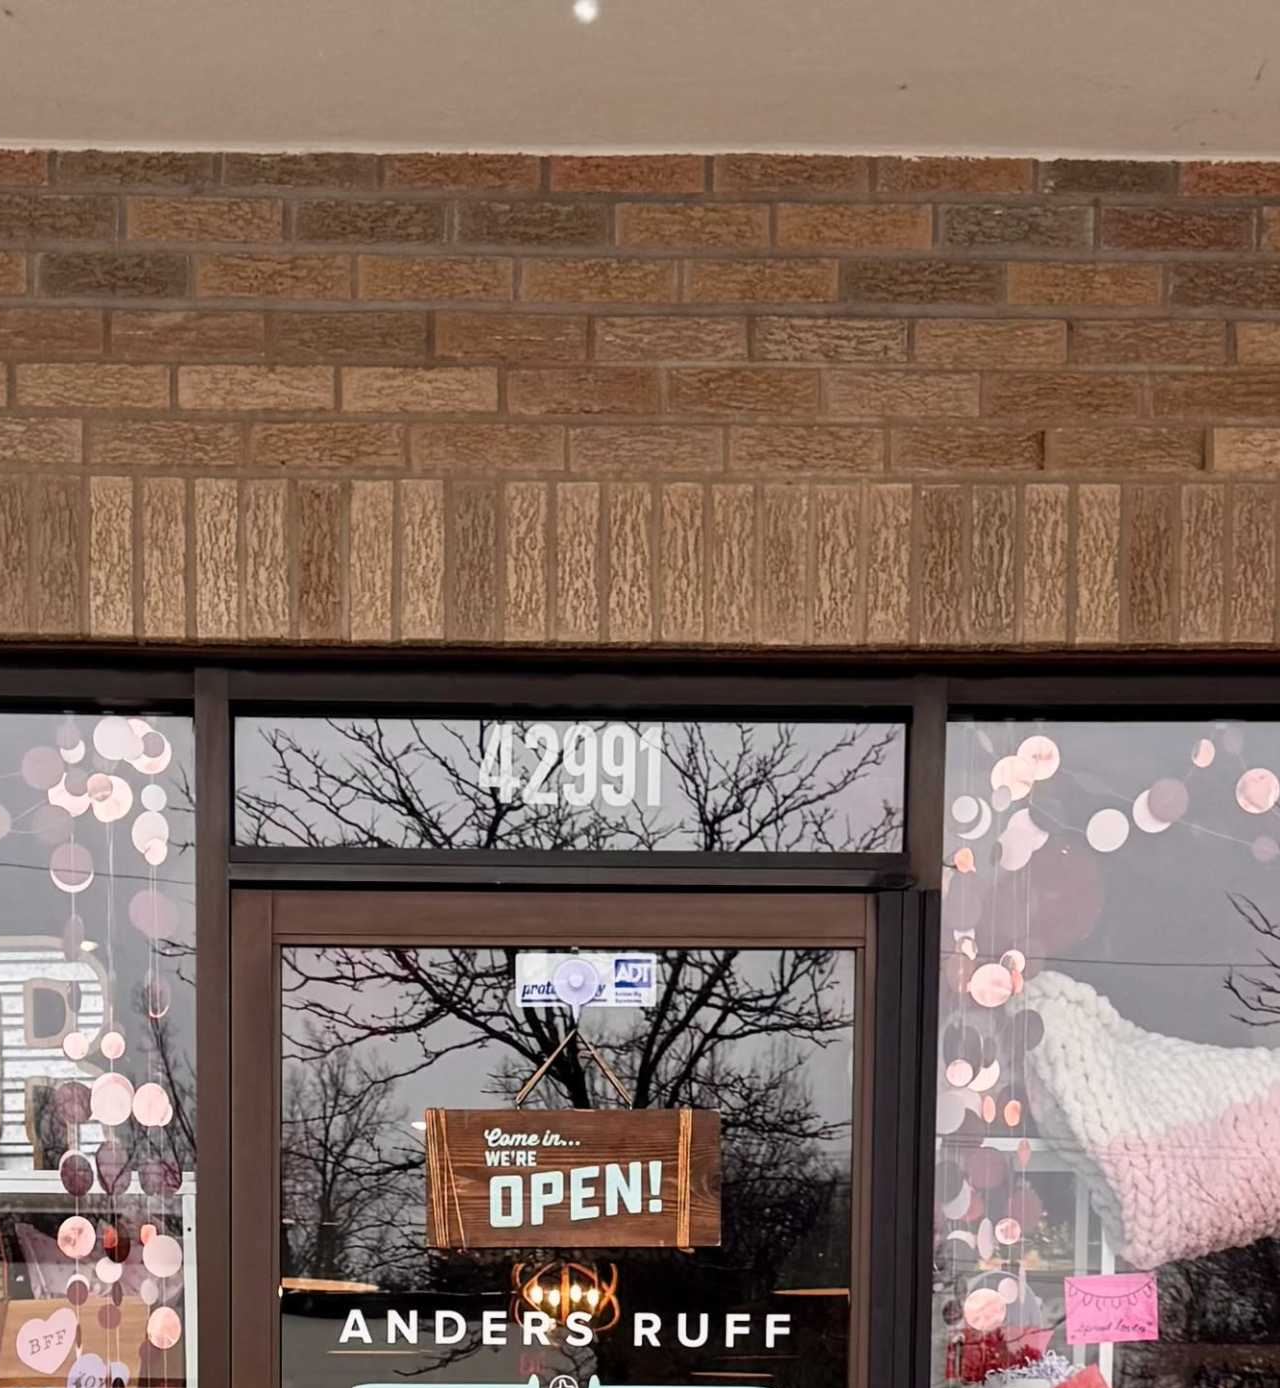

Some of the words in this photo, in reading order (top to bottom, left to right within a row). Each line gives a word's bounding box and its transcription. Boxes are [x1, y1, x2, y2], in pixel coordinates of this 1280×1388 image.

[479, 723, 664, 807] 42991
[615, 962, 651, 983] ADT
[484, 1127, 540, 1147] Come
[485, 1150, 538, 1168] WE'RE
[489, 1159, 663, 1228] OPEN!
[338, 1308, 595, 1347] ANDERS
[632, 1312, 792, 1348] RUFF
[29, 1329, 67, 1356] BFF
